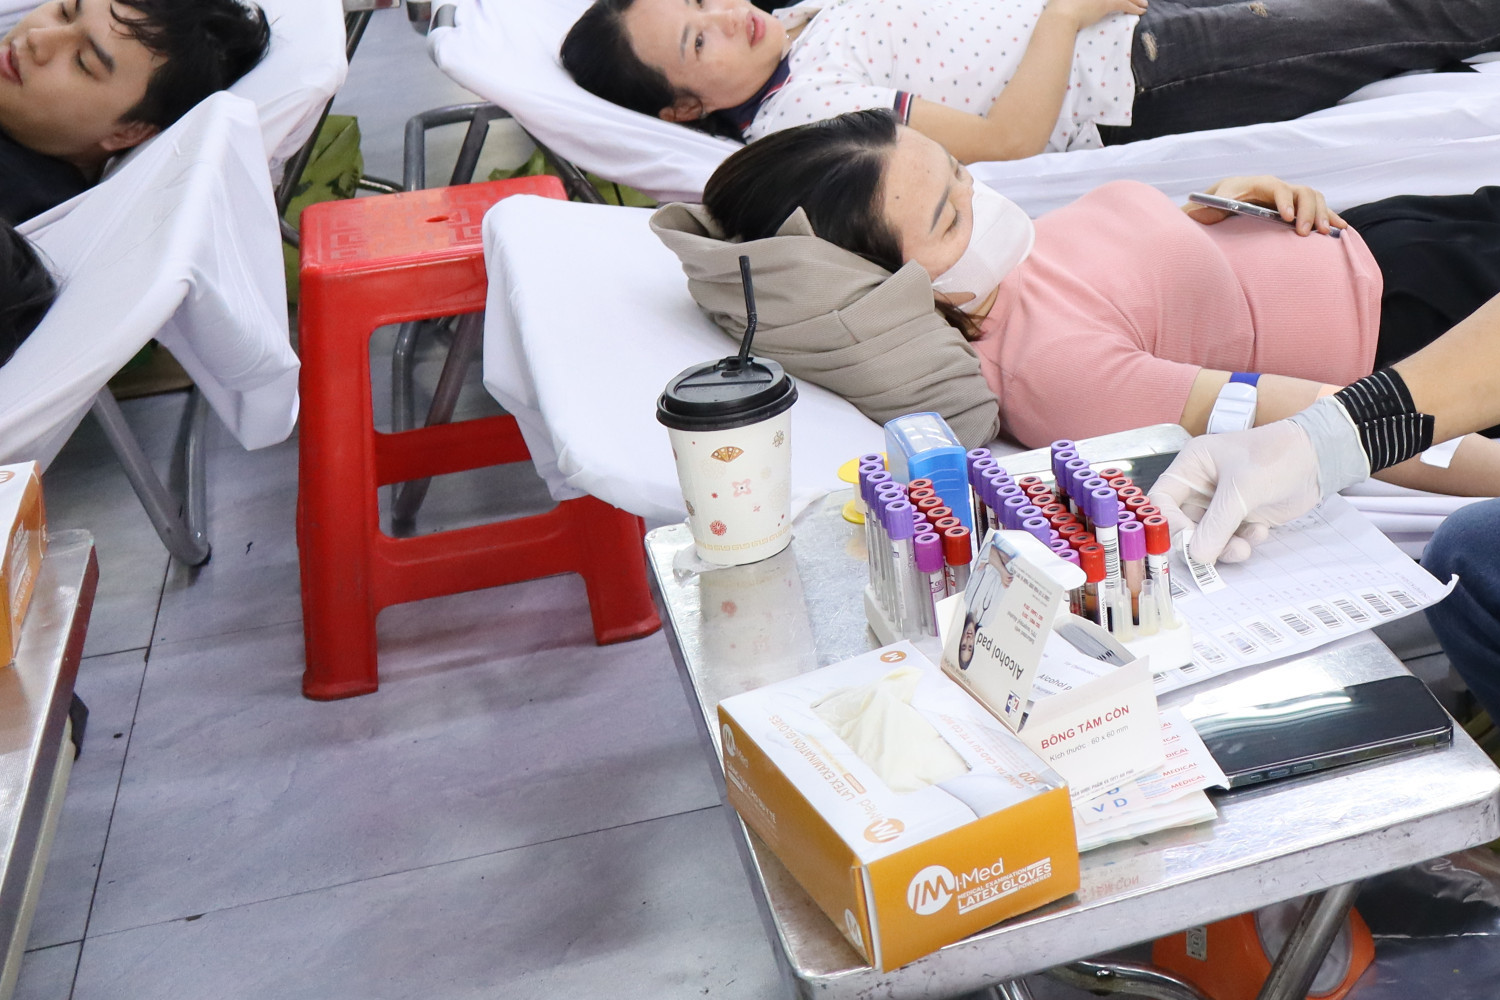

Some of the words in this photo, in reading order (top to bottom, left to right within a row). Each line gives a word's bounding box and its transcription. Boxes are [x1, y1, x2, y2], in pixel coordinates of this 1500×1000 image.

[976, 632, 993, 651] pad
[991, 645, 1024, 680] Alcohol
[1041, 728, 1075, 749] BÔNG
[791, 736, 836, 781] EXAMINATION
[1165, 747, 1190, 758] DICAL
[1018, 771, 1040, 785] 100
[1162, 762, 1198, 777] MEDICAL
[829, 776, 855, 801] LATEX
[1170, 774, 1207, 790] MEDICAL
[959, 884, 986, 899] MEDICAL
[986, 867, 1028, 887] EXAMINATION
[960, 884, 999, 909] LATEX
[1001, 861, 1052, 891] GLOVES
[1018, 872, 1052, 891] POWDERED
